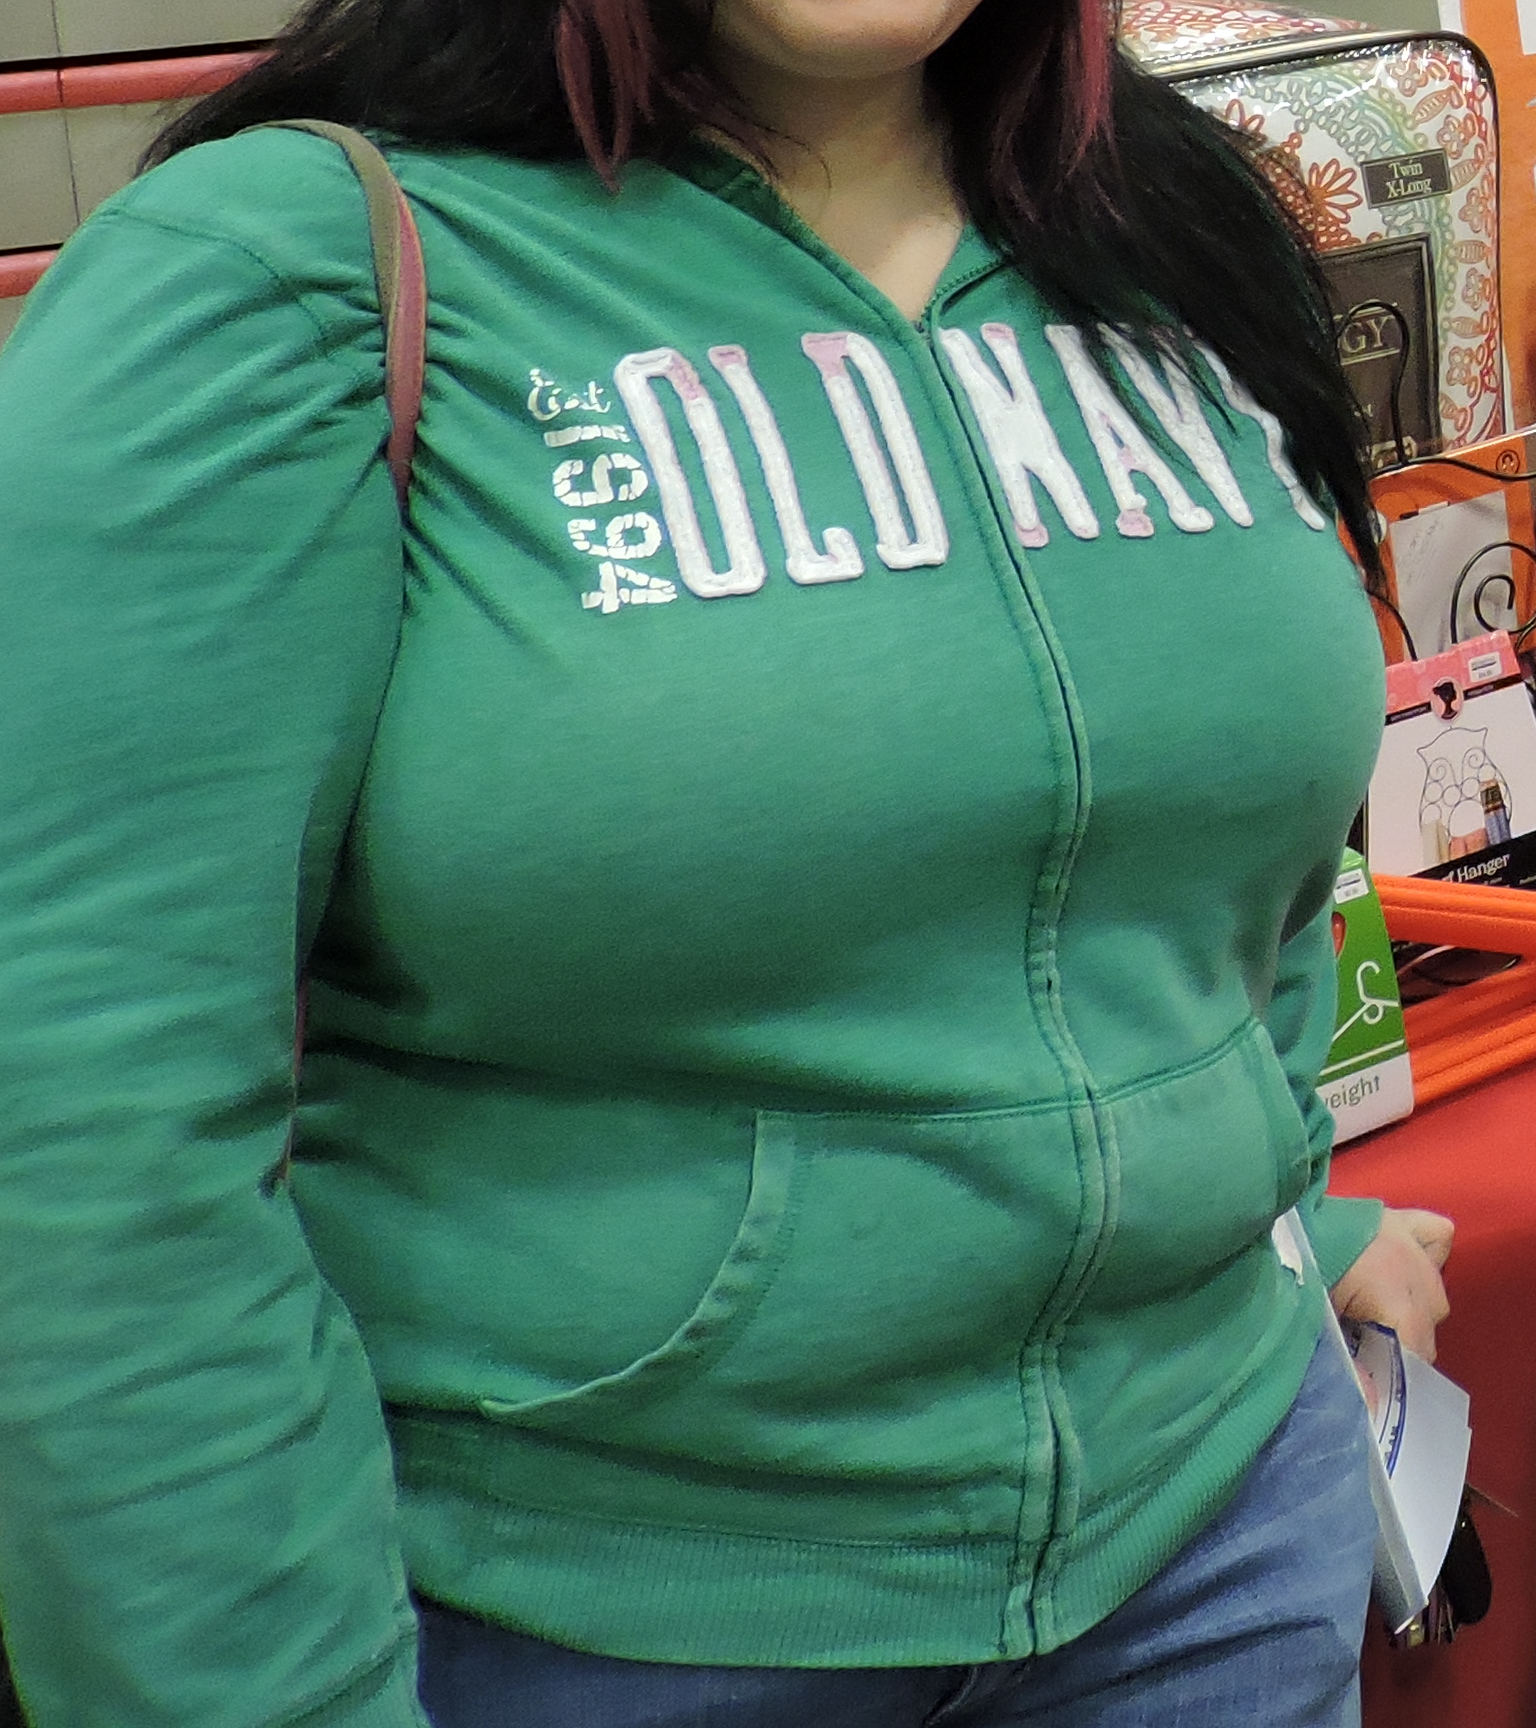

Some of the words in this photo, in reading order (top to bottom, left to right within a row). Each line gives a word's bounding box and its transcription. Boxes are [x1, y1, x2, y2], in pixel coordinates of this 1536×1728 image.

[1389, 158, 1423, 178] Twin
[1385, 178, 1432, 199] X-Long
[613, 331, 949, 599] OLD
[1457, 854, 1510, 882] Hanger
